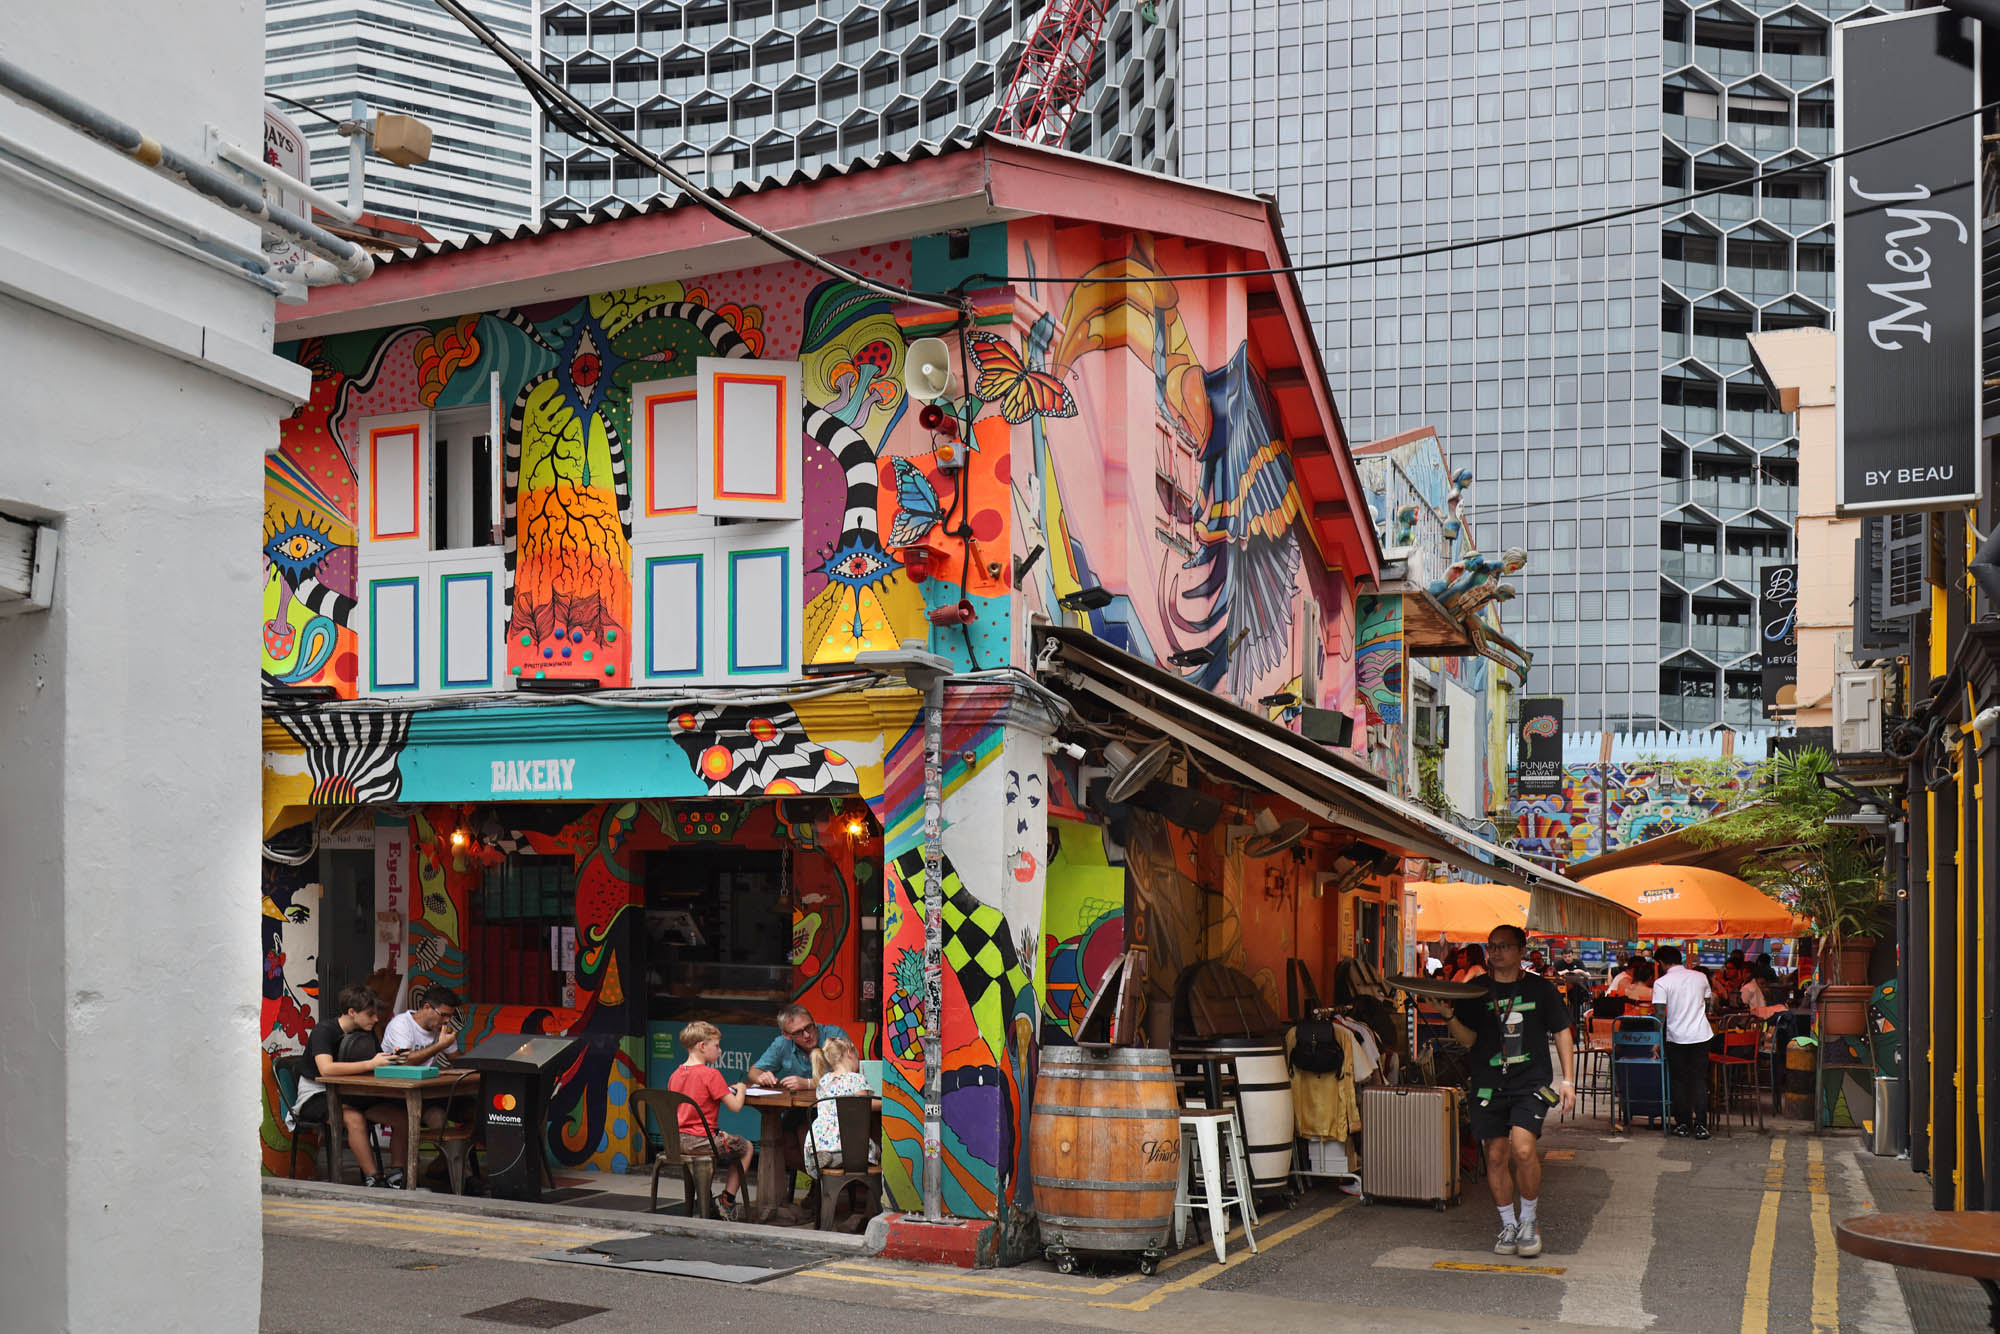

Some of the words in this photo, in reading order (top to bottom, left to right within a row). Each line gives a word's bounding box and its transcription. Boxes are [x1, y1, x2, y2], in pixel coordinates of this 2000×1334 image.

[1849, 175, 1968, 351] Meyl
[1865, 470, 1892, 487] BY
[1898, 465, 1954, 484] BEAU
[1520, 760, 1561, 771] PUNJABY
[1525, 769, 1555, 777] DAWAT
[490, 758, 577, 793] BAKERY
[1637, 892, 1681, 904] Spritz
[705, 1050, 753, 1073] KERY
[488, 1113, 522, 1123] Welcome
